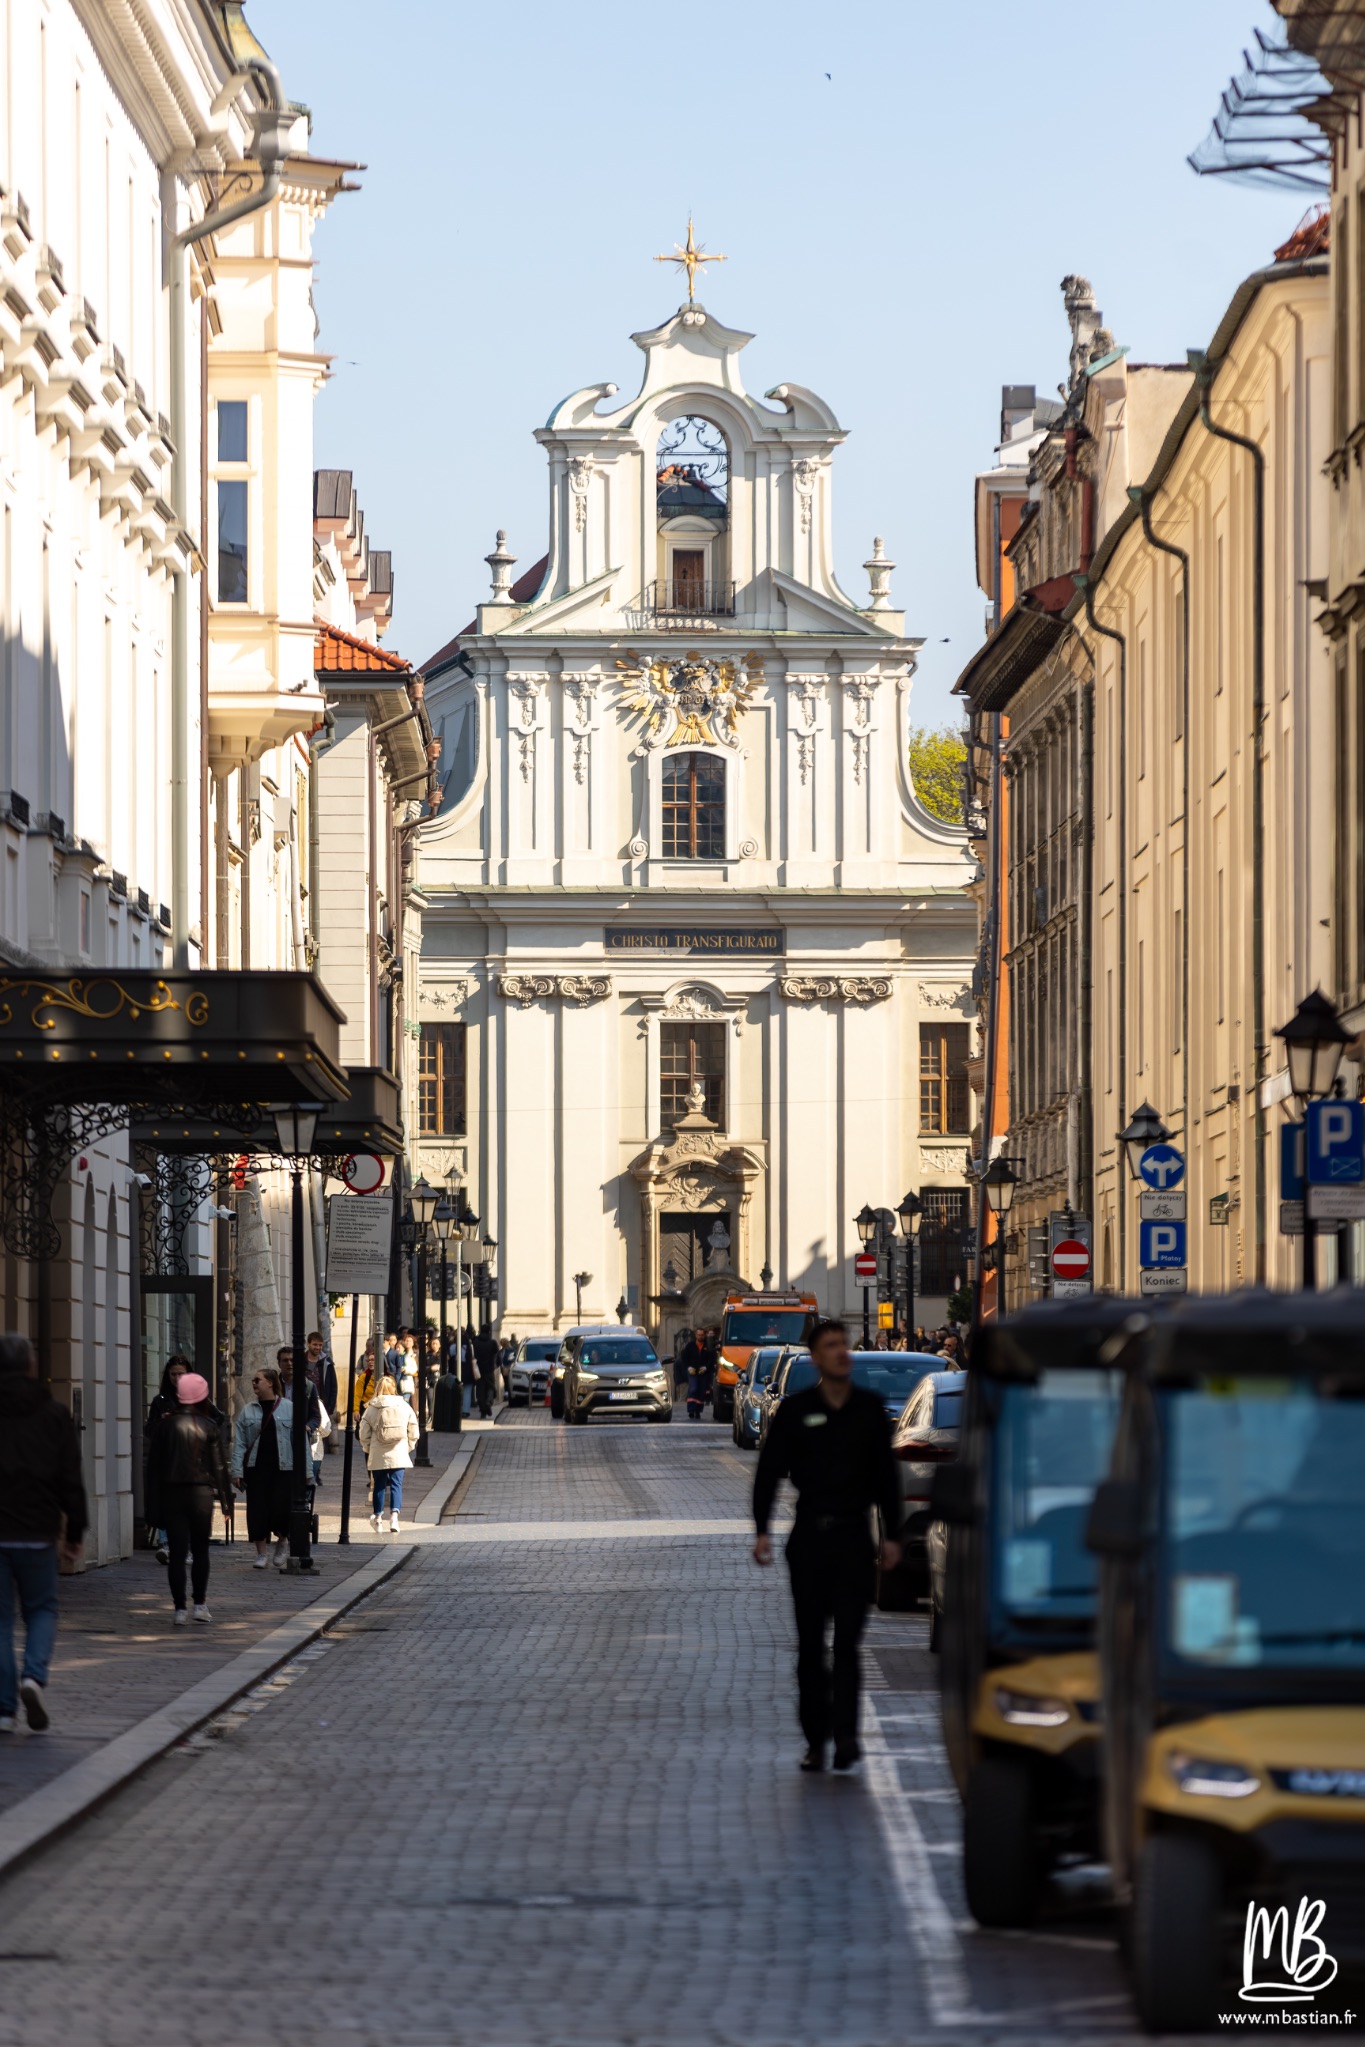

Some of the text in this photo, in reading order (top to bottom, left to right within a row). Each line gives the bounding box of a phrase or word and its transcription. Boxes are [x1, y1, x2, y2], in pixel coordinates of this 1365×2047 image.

[611, 934, 777, 948] CHRISTO TRANSFIGURATO
[1321, 1106, 1353, 1157] P
[1151, 1226, 1177, 1261] P
[1145, 1275, 1180, 1285] Koniec
